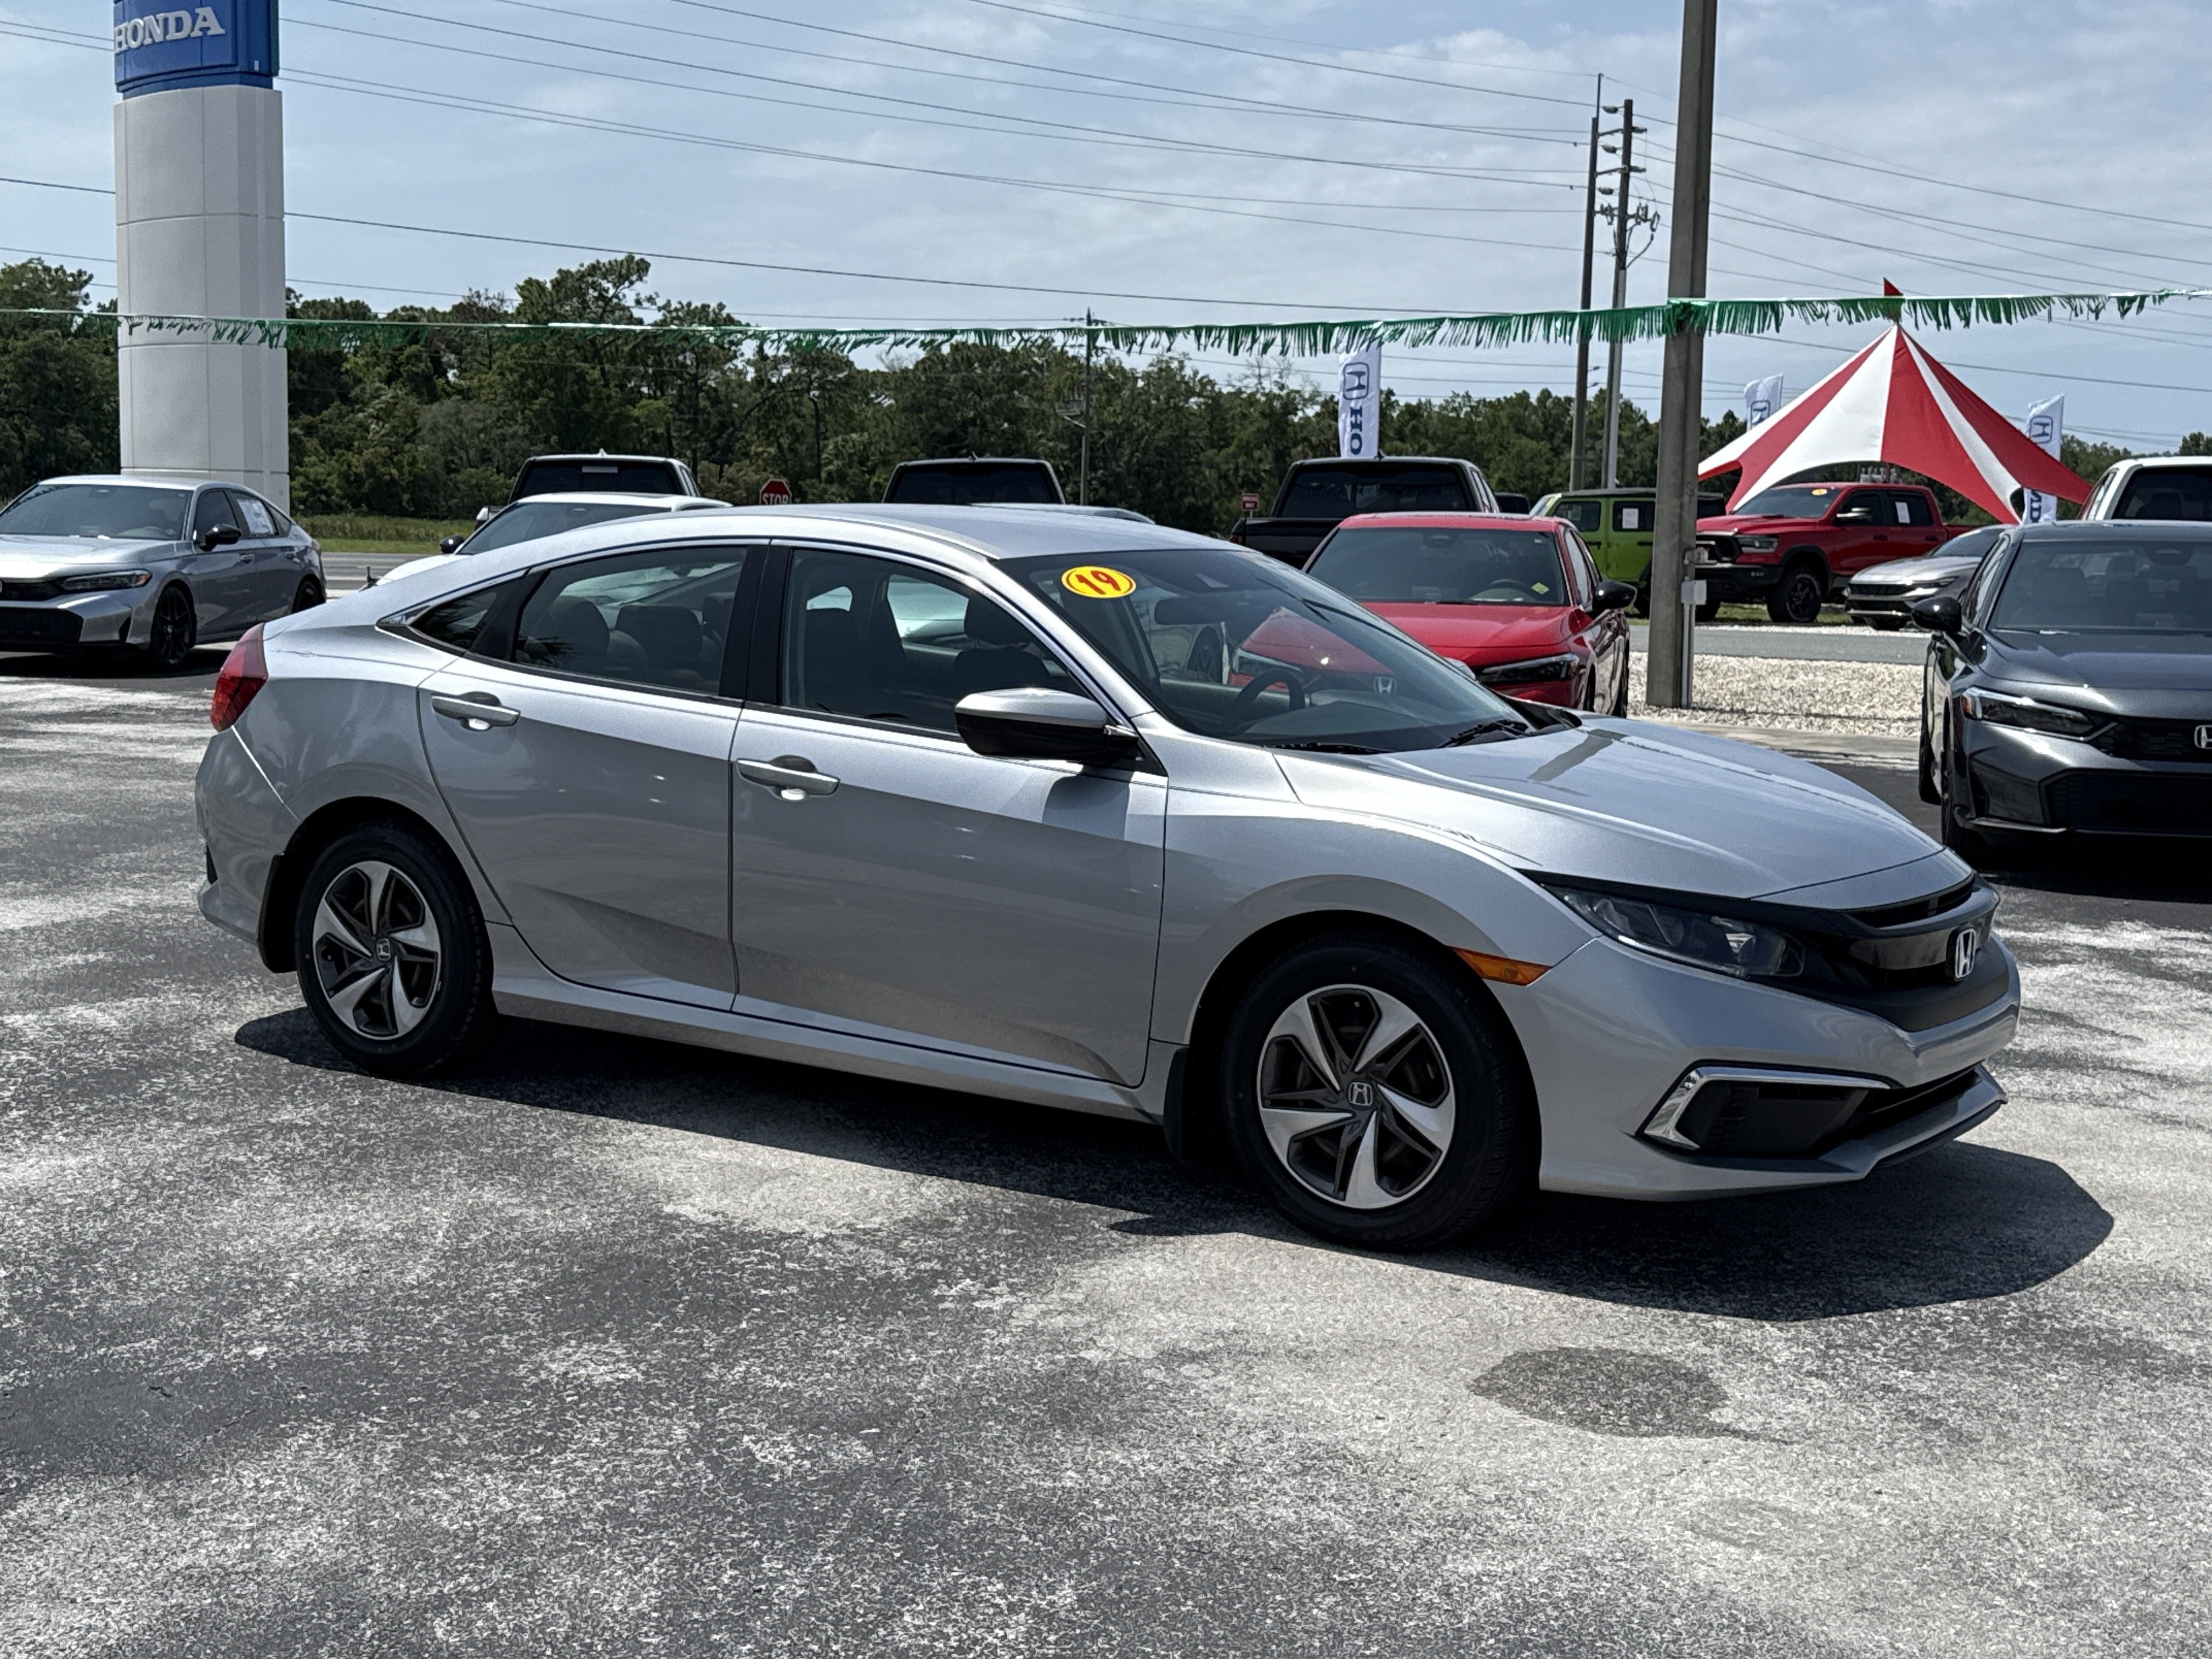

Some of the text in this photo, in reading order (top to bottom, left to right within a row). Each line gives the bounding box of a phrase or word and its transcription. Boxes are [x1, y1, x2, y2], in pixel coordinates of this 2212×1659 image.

[114, 6, 226, 54] HONDA
[762, 493, 789, 505] STOP
[1075, 570, 1122, 595] 19
